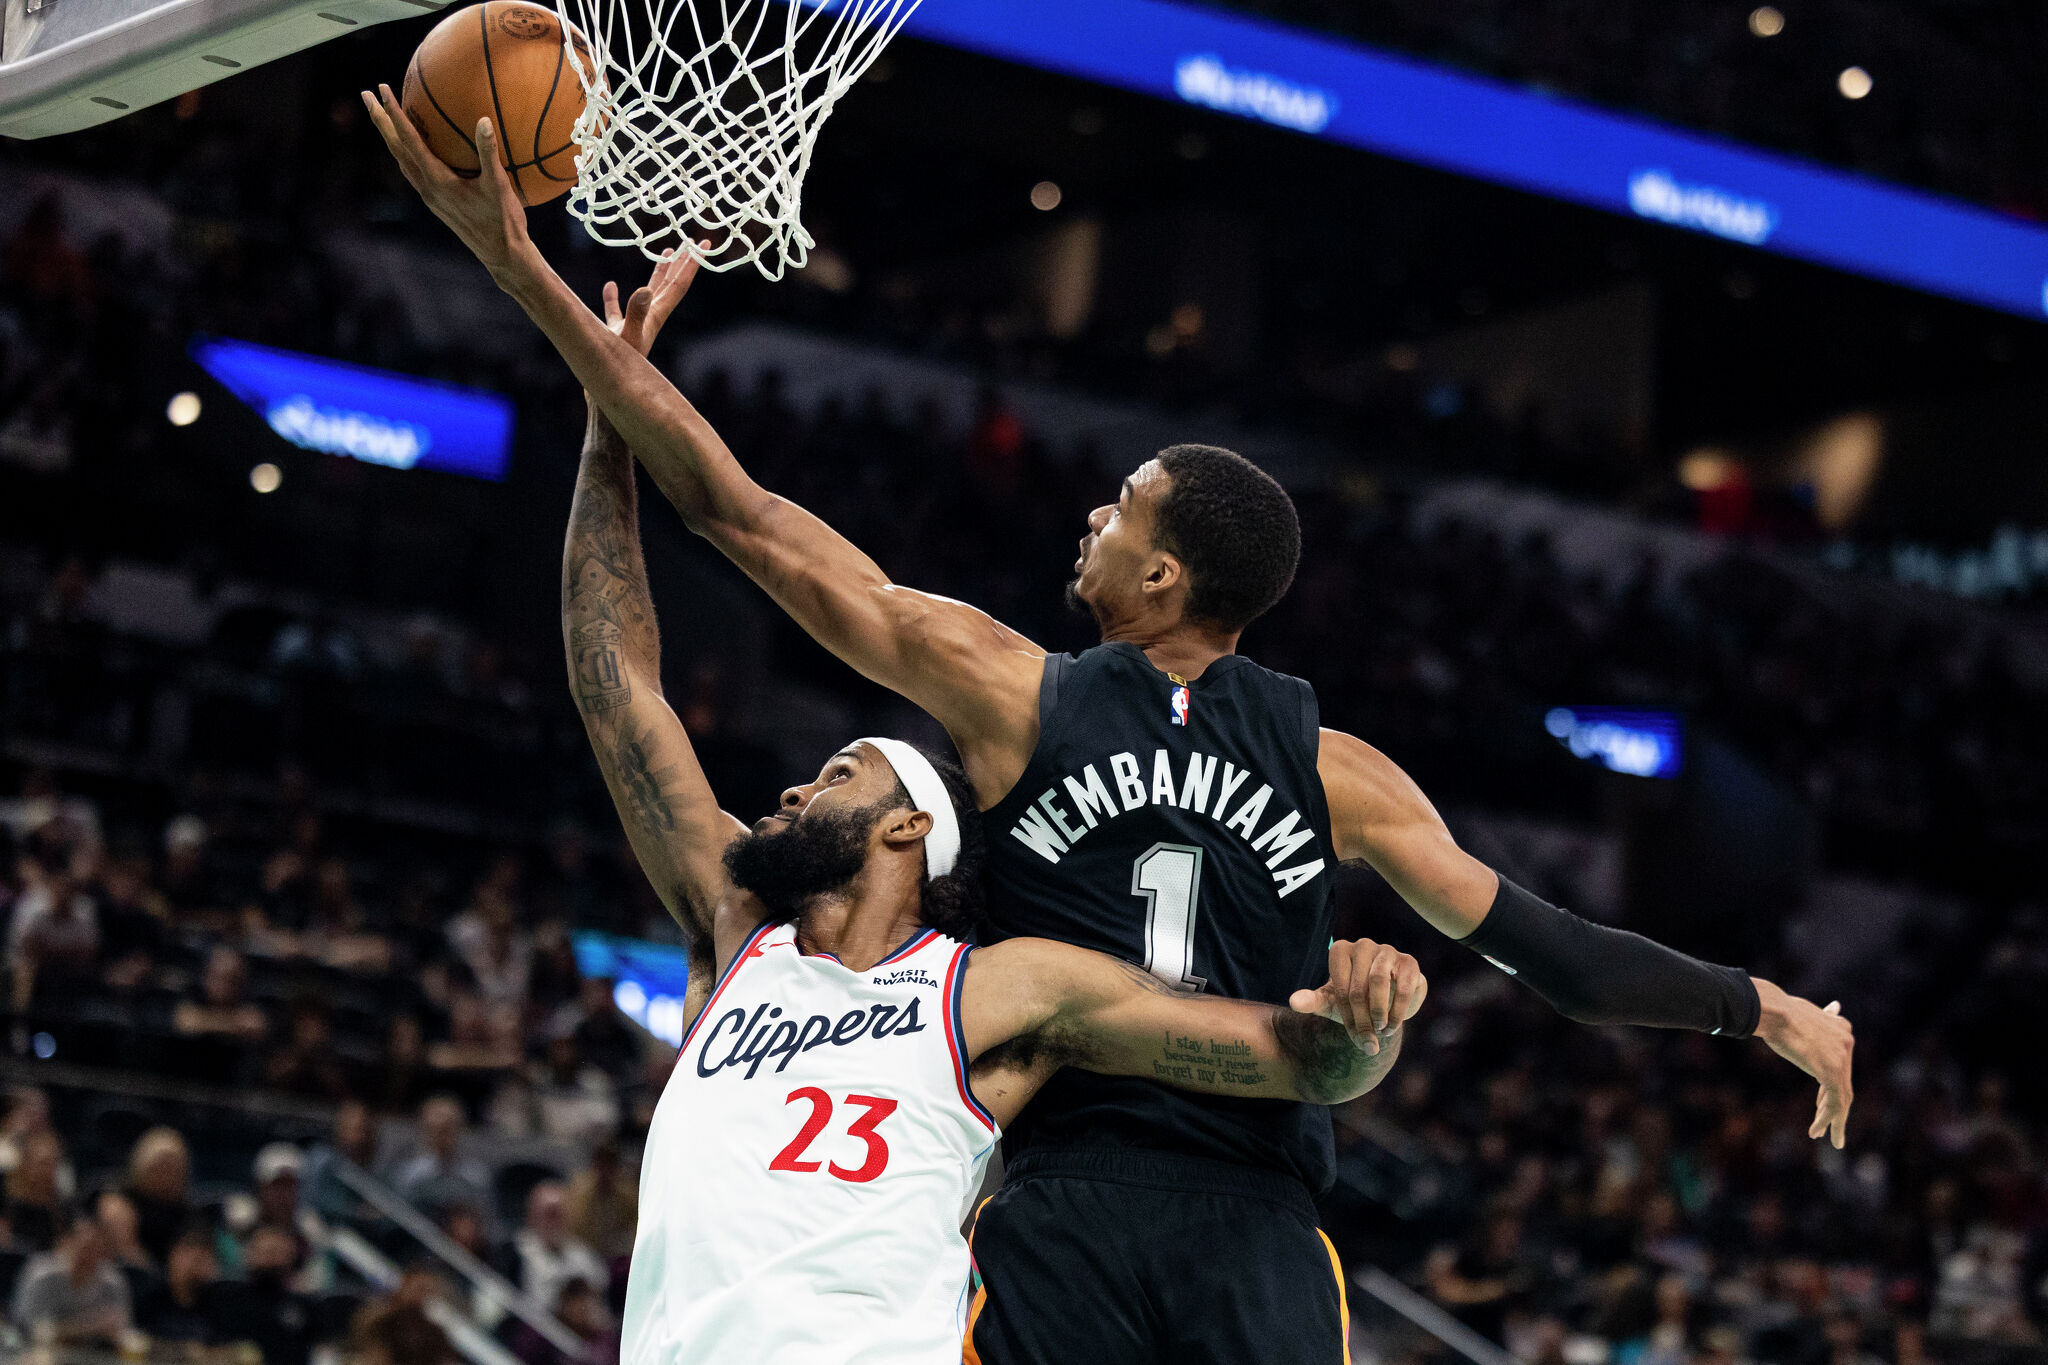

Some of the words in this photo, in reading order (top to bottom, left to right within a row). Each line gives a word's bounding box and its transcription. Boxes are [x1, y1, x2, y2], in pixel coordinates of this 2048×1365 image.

[1010, 749, 1325, 899] WEMBANYAMA
[1131, 842, 1208, 993] 1
[873, 976, 938, 988] RWANDA
[890, 969, 928, 978] VISIT
[697, 996, 927, 1080] Clippers
[1165, 1031, 1170, 1045] I
[1176, 1036, 1203, 1053] stay
[1210, 1039, 1251, 1056] humble
[1163, 1048, 1214, 1065] because
[1225, 1060, 1258, 1071] never
[1153, 1060, 1193, 1079] forget
[1197, 1068, 1216, 1083] my
[1221, 1070, 1267, 1085] struggle
[768, 1086, 898, 1183] 23
